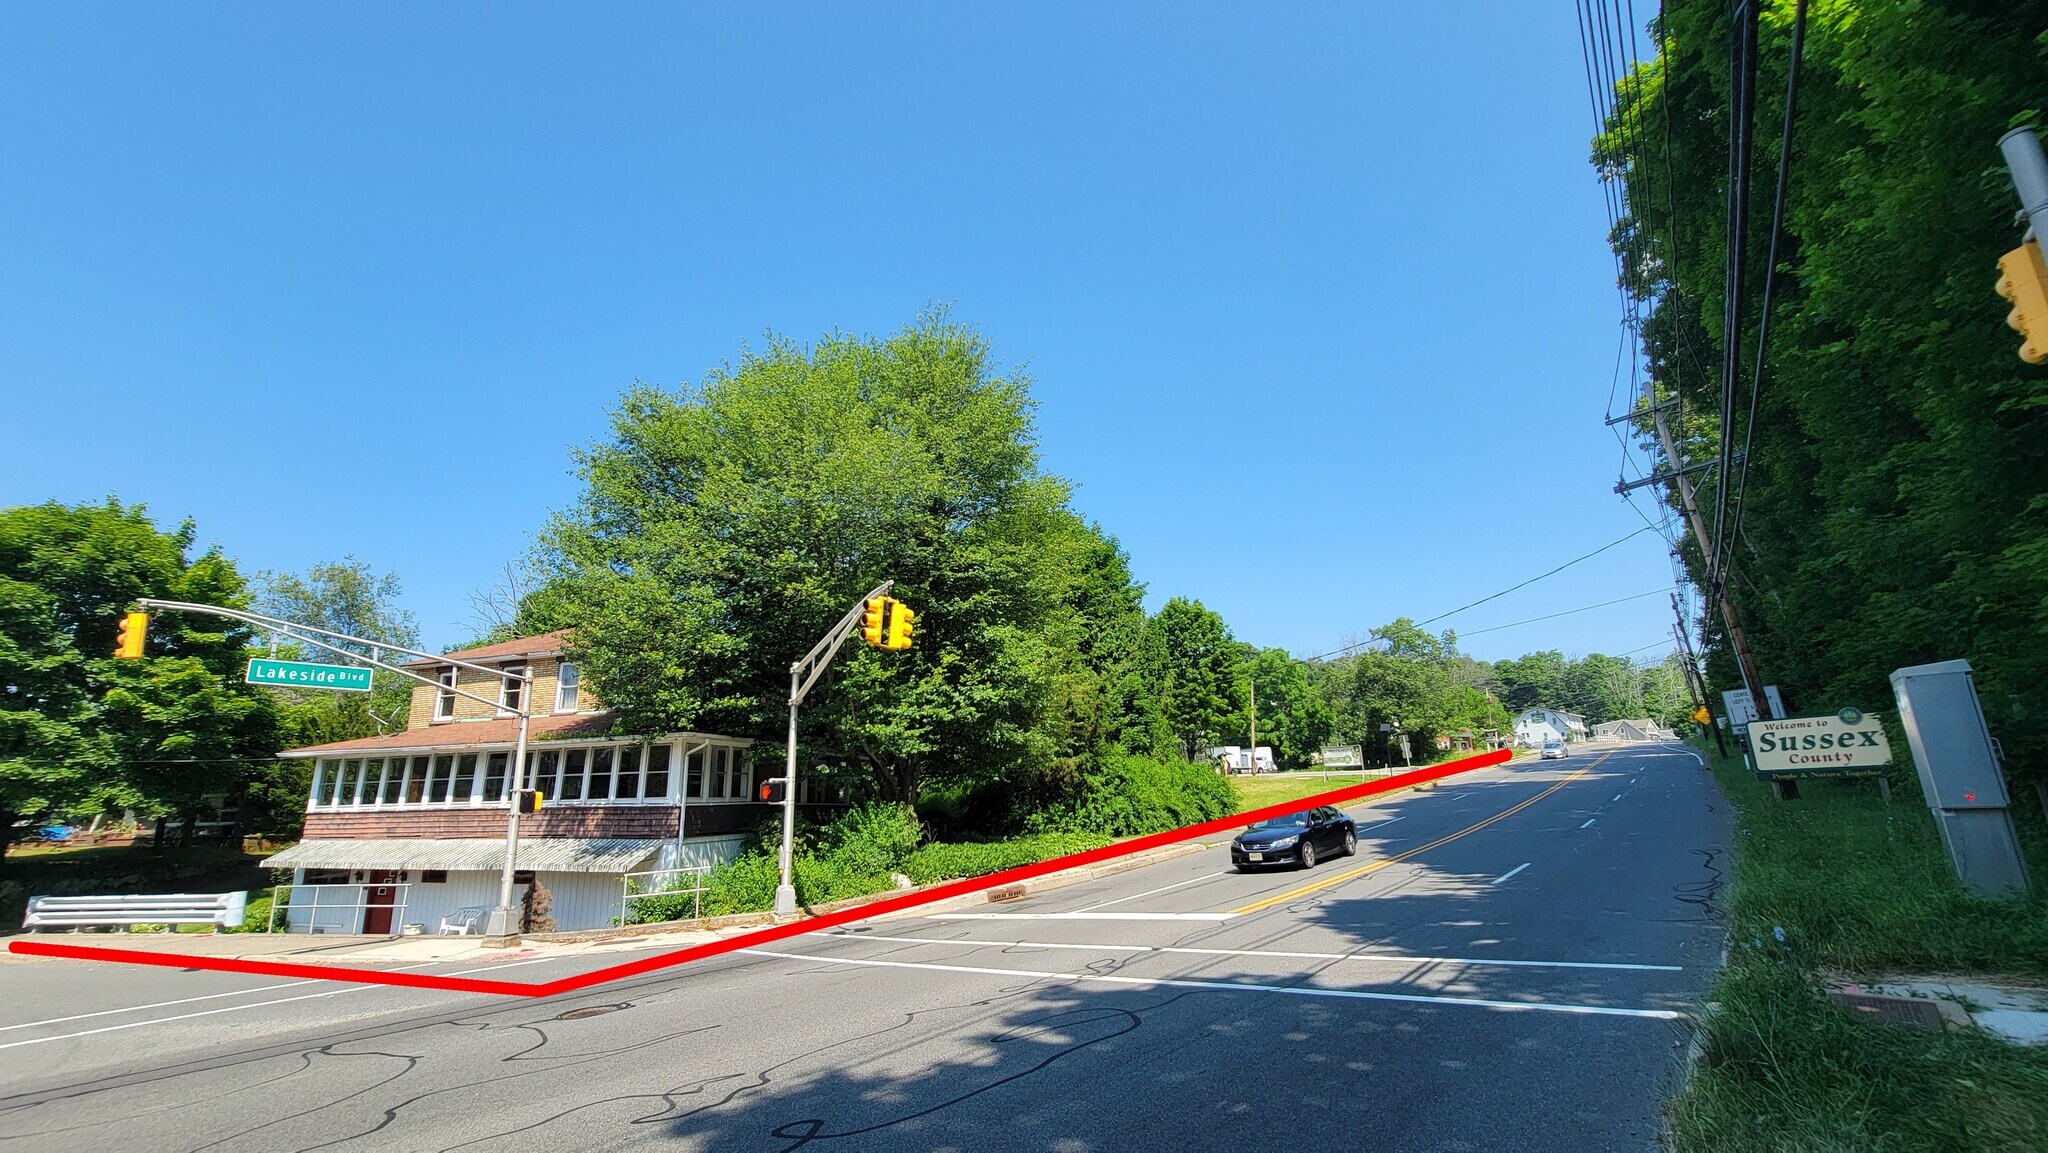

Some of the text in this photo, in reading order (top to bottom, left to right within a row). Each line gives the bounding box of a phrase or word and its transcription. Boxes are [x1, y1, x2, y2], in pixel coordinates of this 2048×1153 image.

[256, 665, 364, 683] Lakeside Blvd
[1764, 719, 1828, 731] Welcome to
[1759, 730, 1879, 753] Sussex
[1789, 751, 1853, 766] County
[1844, 769, 1882, 777] Together
